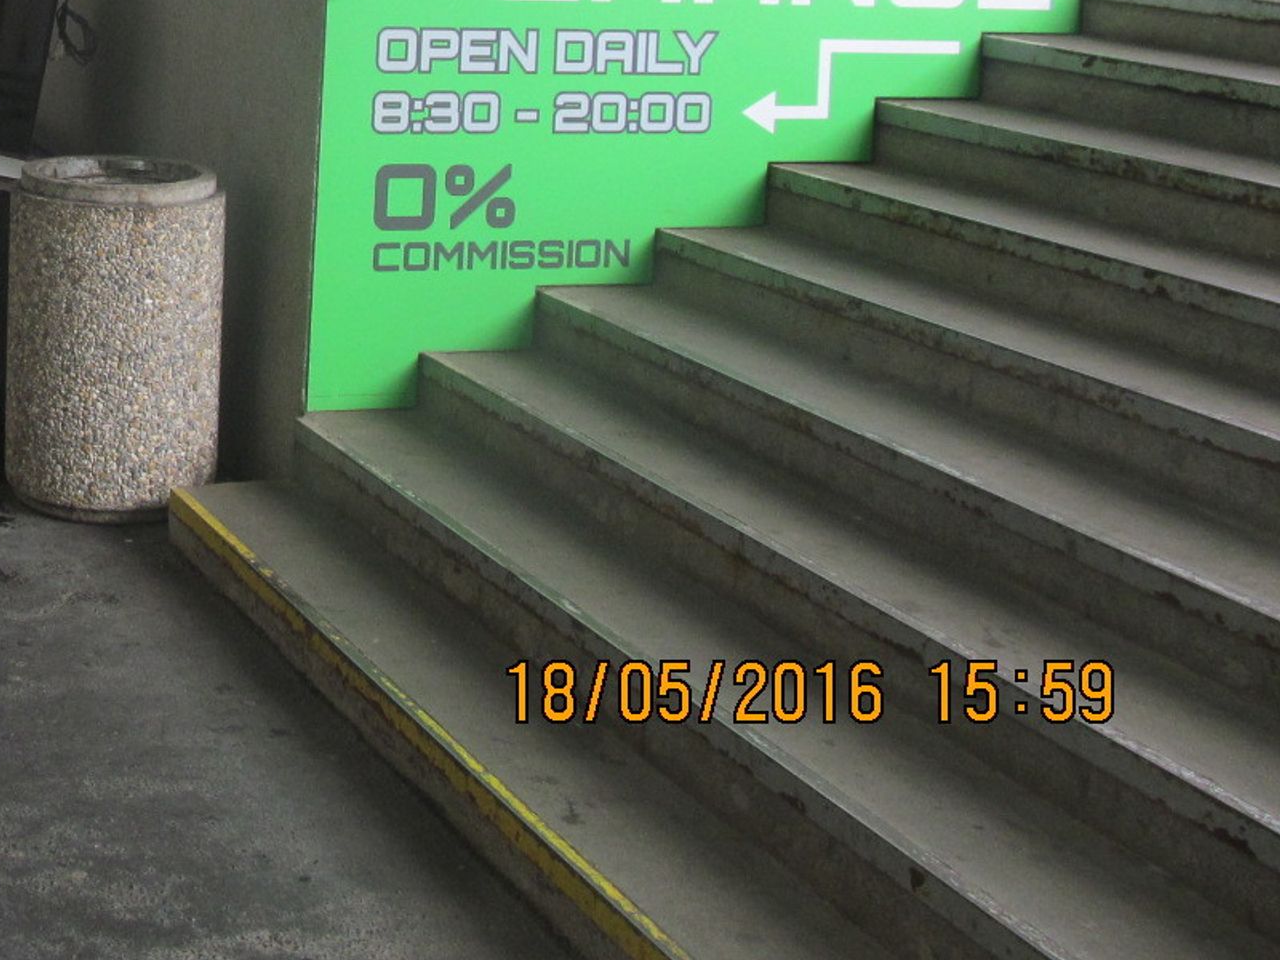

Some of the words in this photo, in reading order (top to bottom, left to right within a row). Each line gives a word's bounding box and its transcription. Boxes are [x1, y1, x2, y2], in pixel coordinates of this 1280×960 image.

[375, 26, 540, 74] OPEN
[553, 28, 719, 77] DAILY
[370, 90, 502, 135] 8:30
[551, 90, 713, 135] 20:00
[373, 162, 517, 231] 0%
[372, 238, 630, 273] COMMISSION
